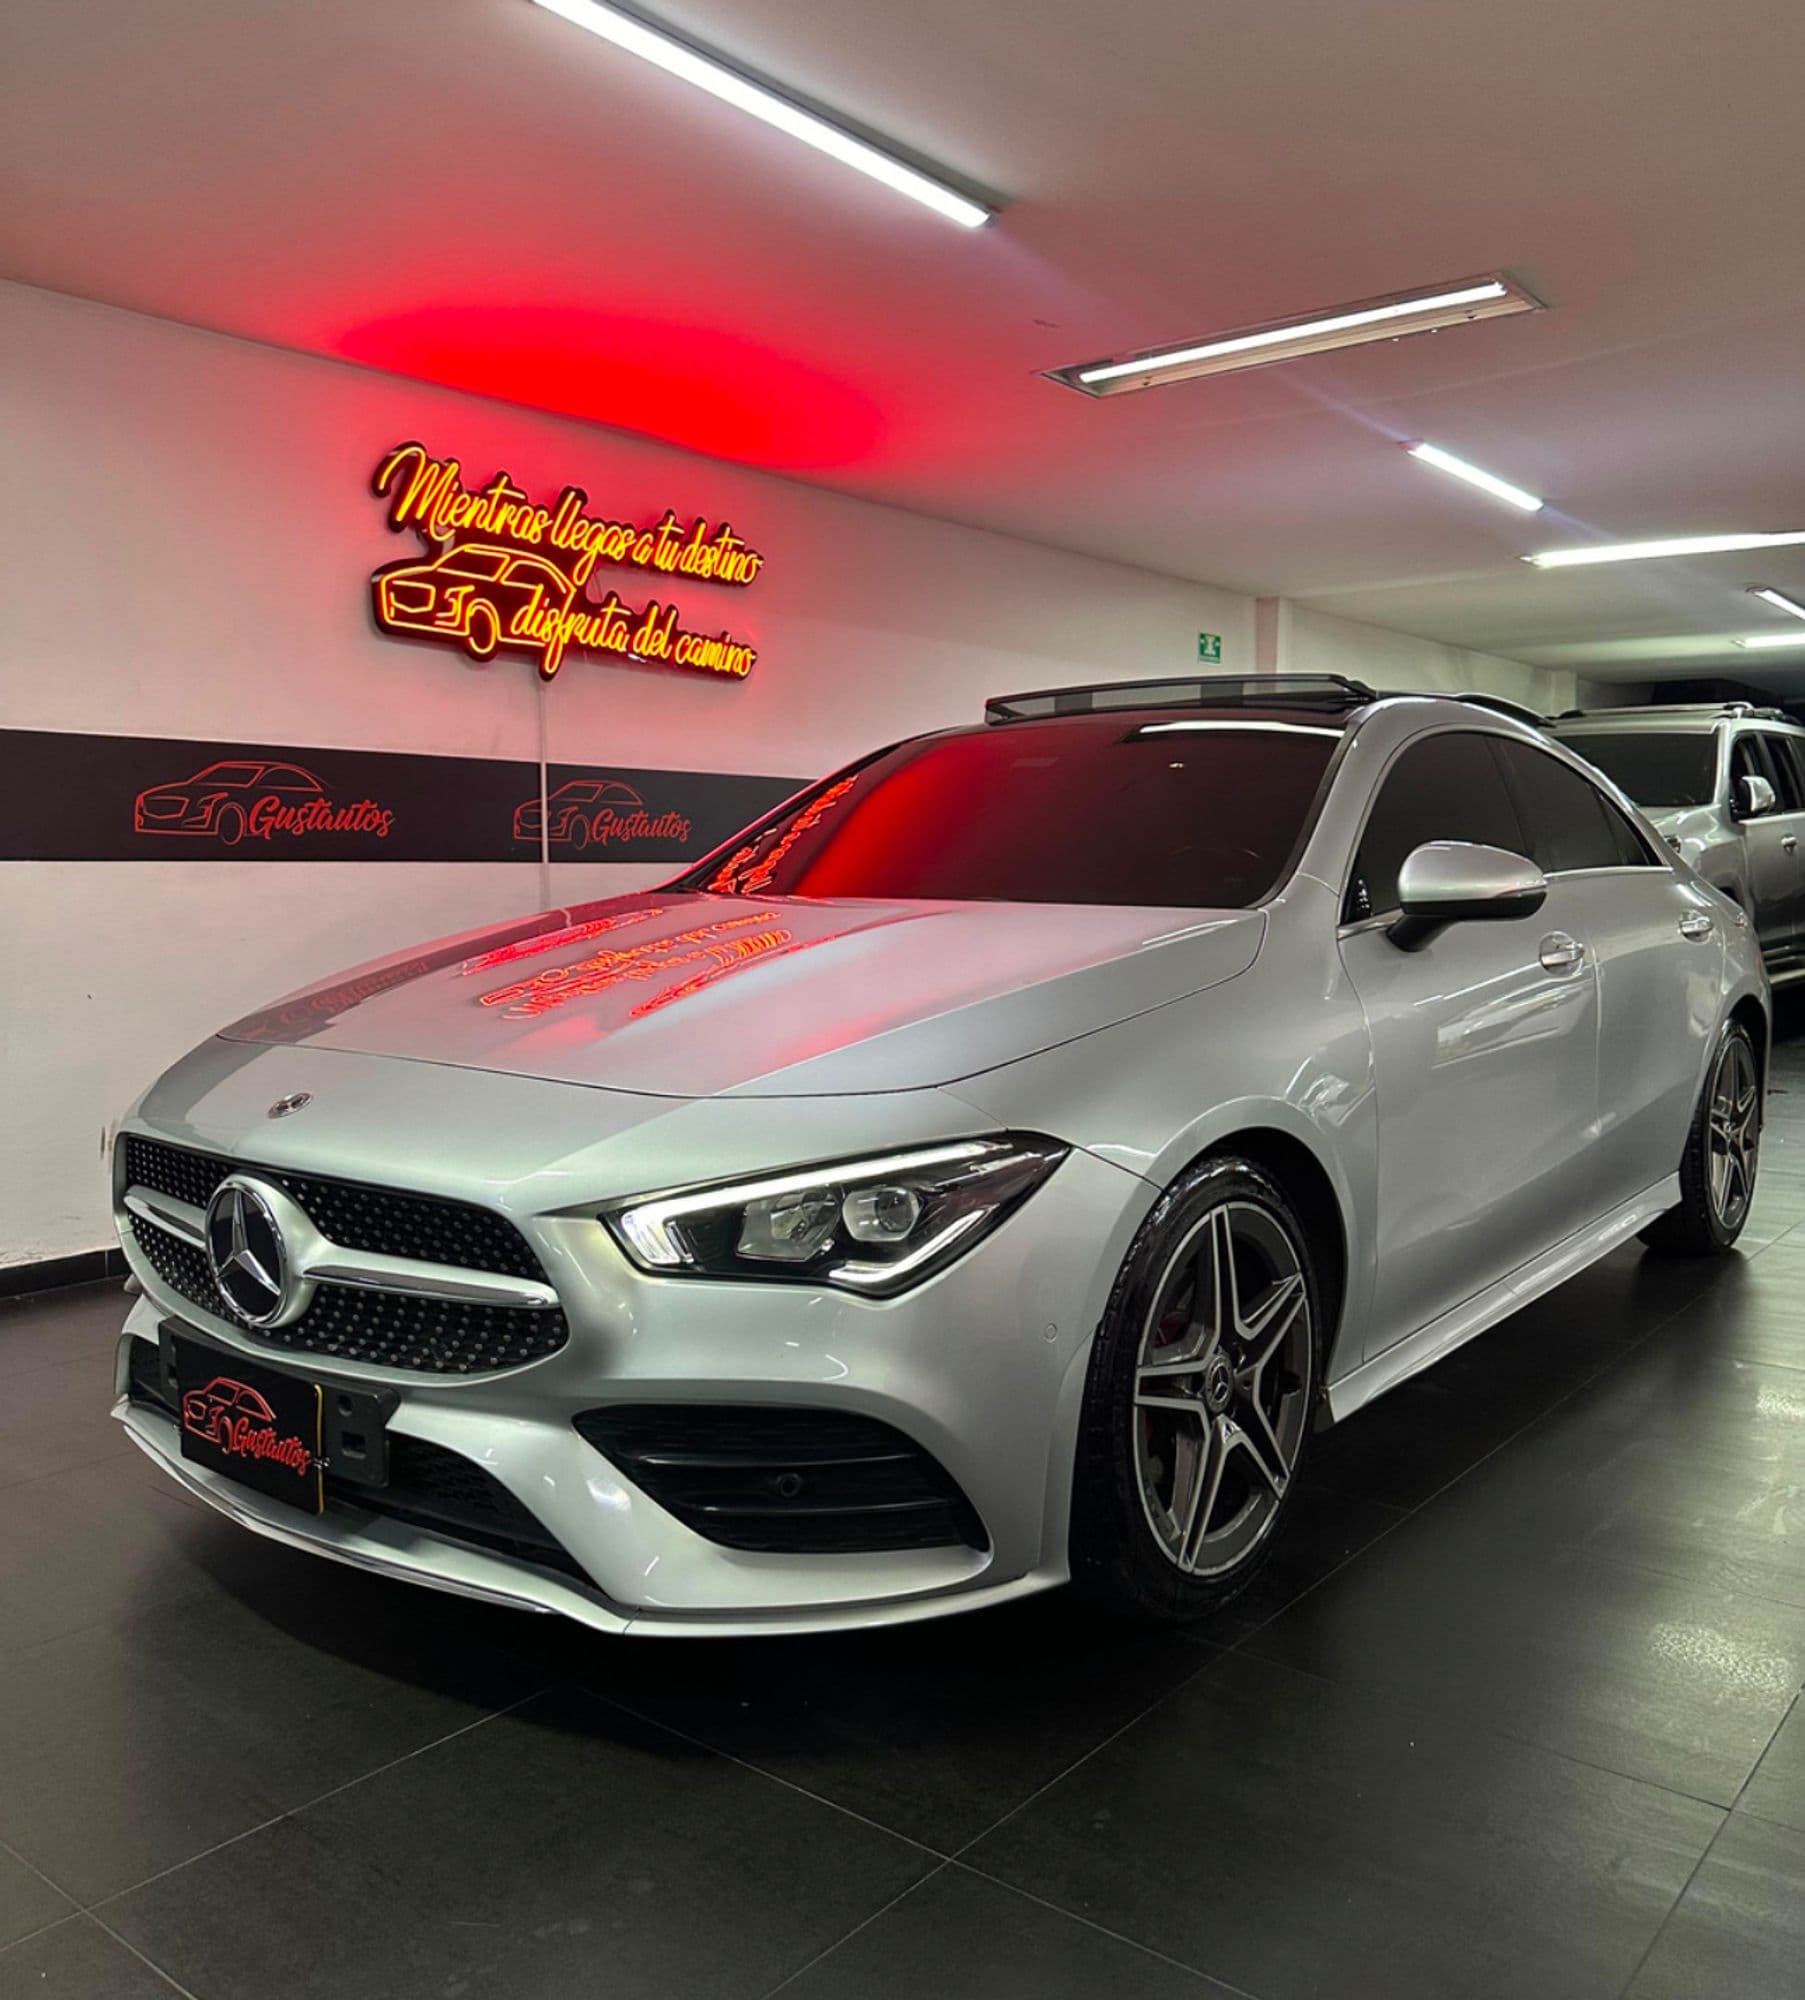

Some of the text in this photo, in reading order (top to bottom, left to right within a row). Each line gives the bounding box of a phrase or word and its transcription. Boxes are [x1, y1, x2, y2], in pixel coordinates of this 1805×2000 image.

[378, 446, 763, 585] Mientras llegas a tu destino
[511, 583, 756, 677] disfruta del camino
[248, 796, 396, 839] Gustautos
[592, 808, 692, 845] Gustautos
[231, 1417, 312, 1476] Gustautos
